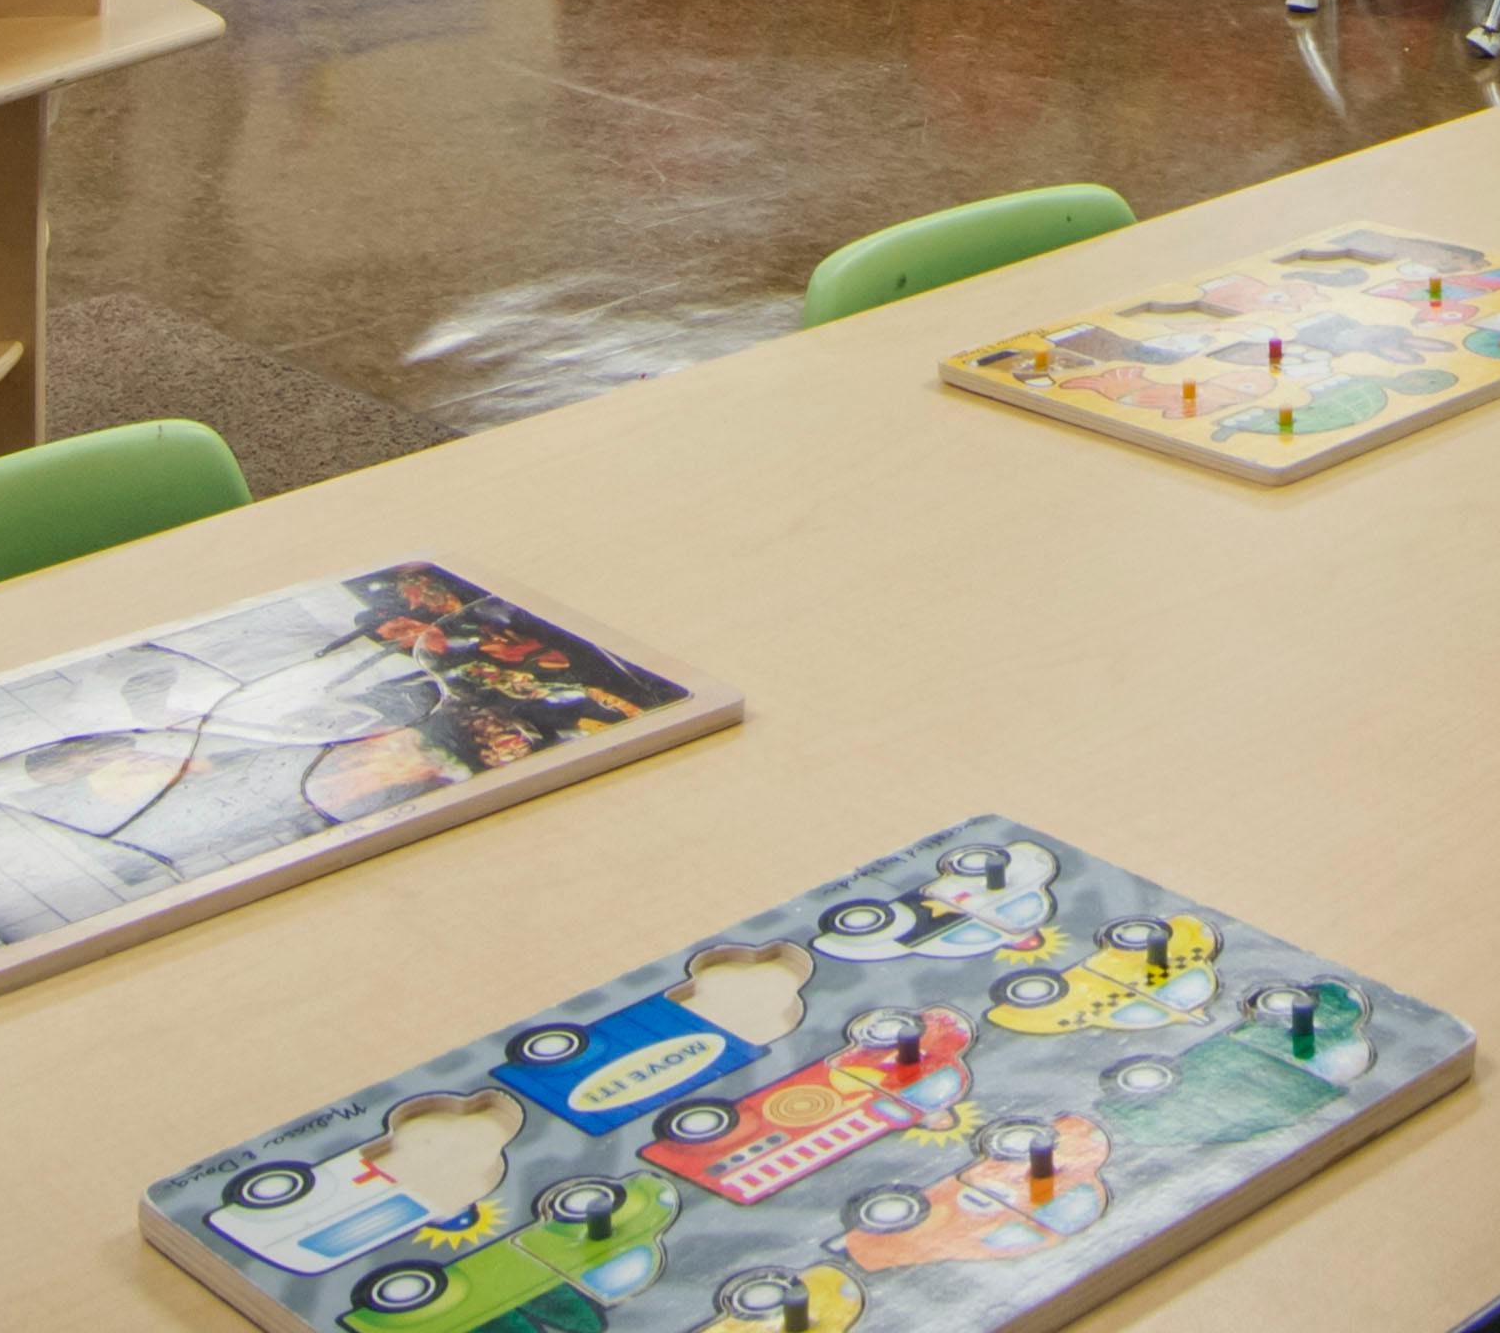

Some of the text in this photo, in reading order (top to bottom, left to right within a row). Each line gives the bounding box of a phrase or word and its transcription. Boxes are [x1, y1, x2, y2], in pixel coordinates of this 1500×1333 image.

[584, 1041, 709, 1104] MOVE IT!
[262, 1102, 368, 1150] Melissa
